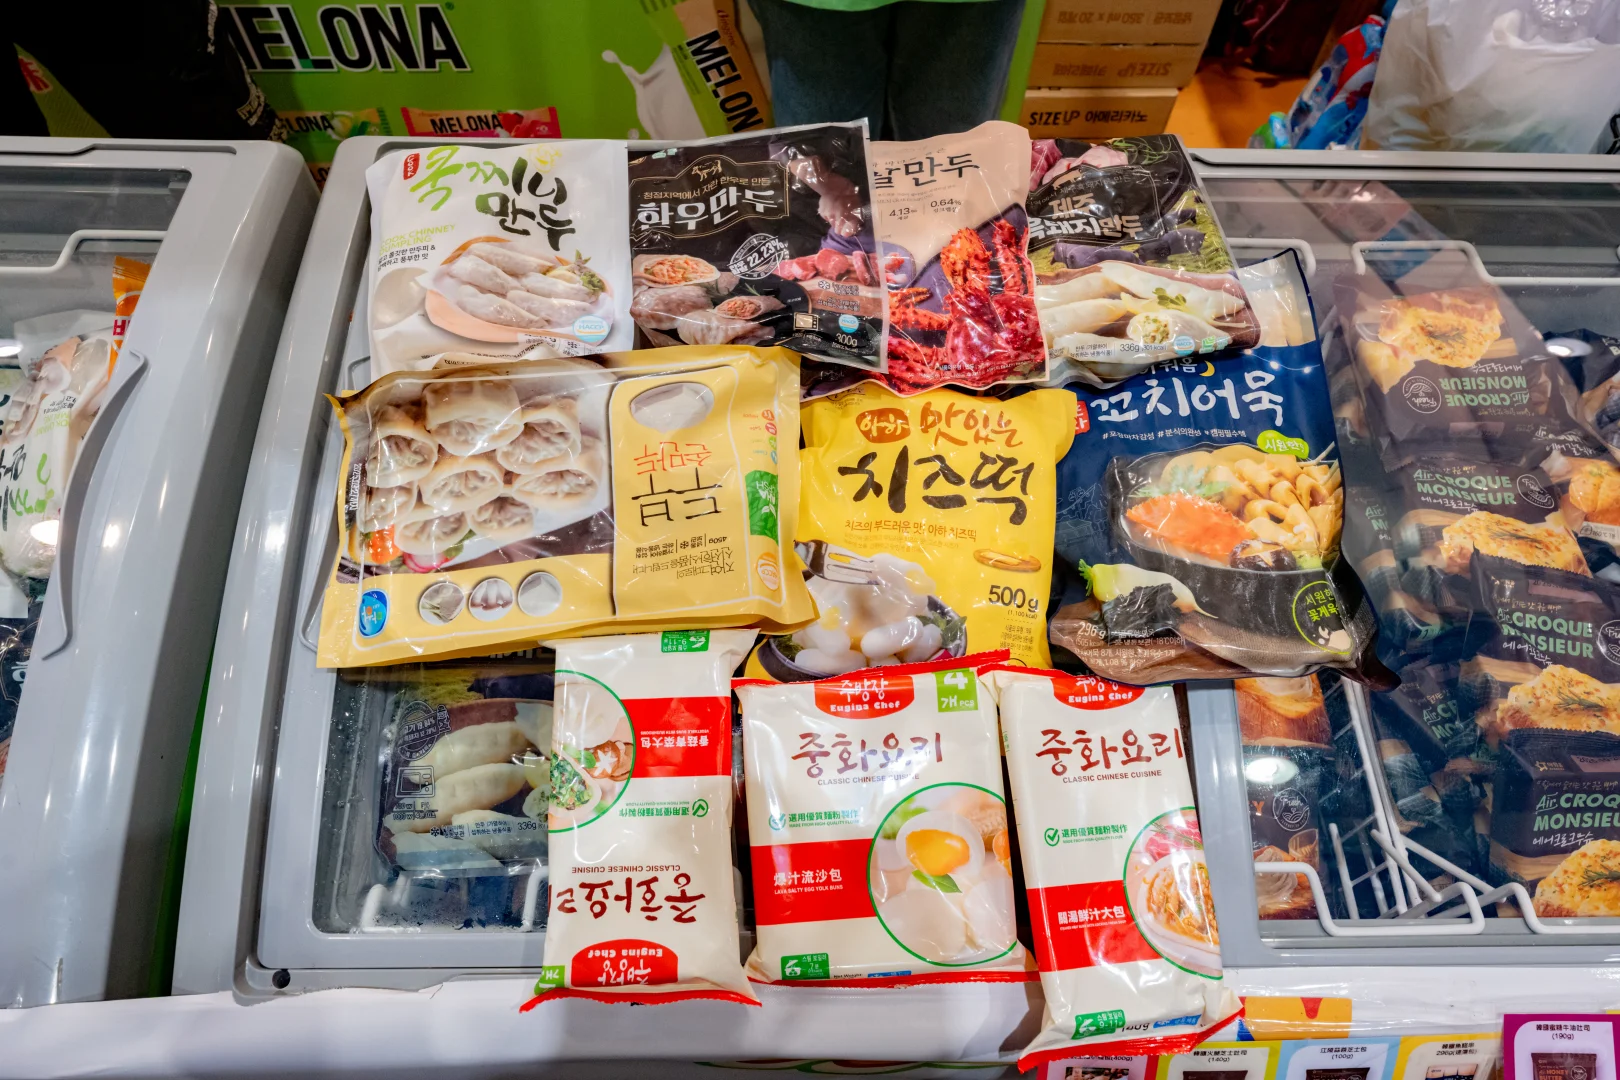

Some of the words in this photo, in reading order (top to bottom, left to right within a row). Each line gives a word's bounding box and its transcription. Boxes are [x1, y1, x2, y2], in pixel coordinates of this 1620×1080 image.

[686, 30, 764, 133] MELON
[279, 114, 334, 133] LONA
[430, 115, 503, 135] MELONA
[1085, 109, 1148, 123] 아메리카노
[637, 186, 778, 231] 한우만두
[475, 192, 576, 251] 만두
[1120, 343, 1140, 352] 336g
[1439, 375, 1527, 390] MONSIEUR
[1090, 370, 1284, 427] 꼬치어묵
[1445, 393, 1510, 407] CROQUE
[920, 401, 1023, 448] 맛있는
[634, 442, 712, 475] 손만두
[837, 445, 1035, 526] 치즈떡
[1434, 473, 1513, 490] CROQUE
[631, 467, 723, 527] 두부
[1416, 483, 1517, 505] MONSIEUR
[845, 519, 873, 532] 치즈의
[874, 519, 911, 533] 부드러운
[928, 524, 947, 537] 아하
[709, 536, 728, 544] 450g
[1512, 611, 1593, 638] CROQUE
[839, 678, 889, 701] 주방장
[943, 671, 968, 690] 4
[830, 703, 869, 713] Eugina
[873, 700, 900, 709] Chef
[959, 699, 975, 708] PCS
[1068, 694, 1104, 703] Eugina
[1108, 692, 1133, 700] Chef
[640, 735, 709, 749] 香菇青菜大包
[791, 732, 944, 778] 중화요리
[1036, 728, 1184, 777] 중화요리
[817, 777, 851, 786] CLASSIC
[852, 775, 886, 783] CHINESE
[888, 773, 920, 781] CUISINE
[1062, 775, 1094, 784] CLASSIC
[1096, 772, 1129, 782] CHINESE
[1131, 769, 1162, 779] CUISINE
[618, 807, 690, 817] 選用優質麵粉製作
[1533, 791, 1559, 815] Air
[1560, 793, 1620, 809] CROQ
[788, 809, 860, 822] 選用優質麵粉製作
[1533, 812, 1620, 832] MONSIEU
[517, 821, 537, 830] 336g
[1061, 824, 1128, 838] 選用優質麵粉製作
[607, 865, 643, 873] CHINESE
[774, 868, 842, 886] 爆汁流沙包
[548, 872, 706, 924] 중화요리
[588, 949, 616, 958] Chef
[622, 948, 663, 957] Eugina
[597, 958, 651, 985] 주방장
